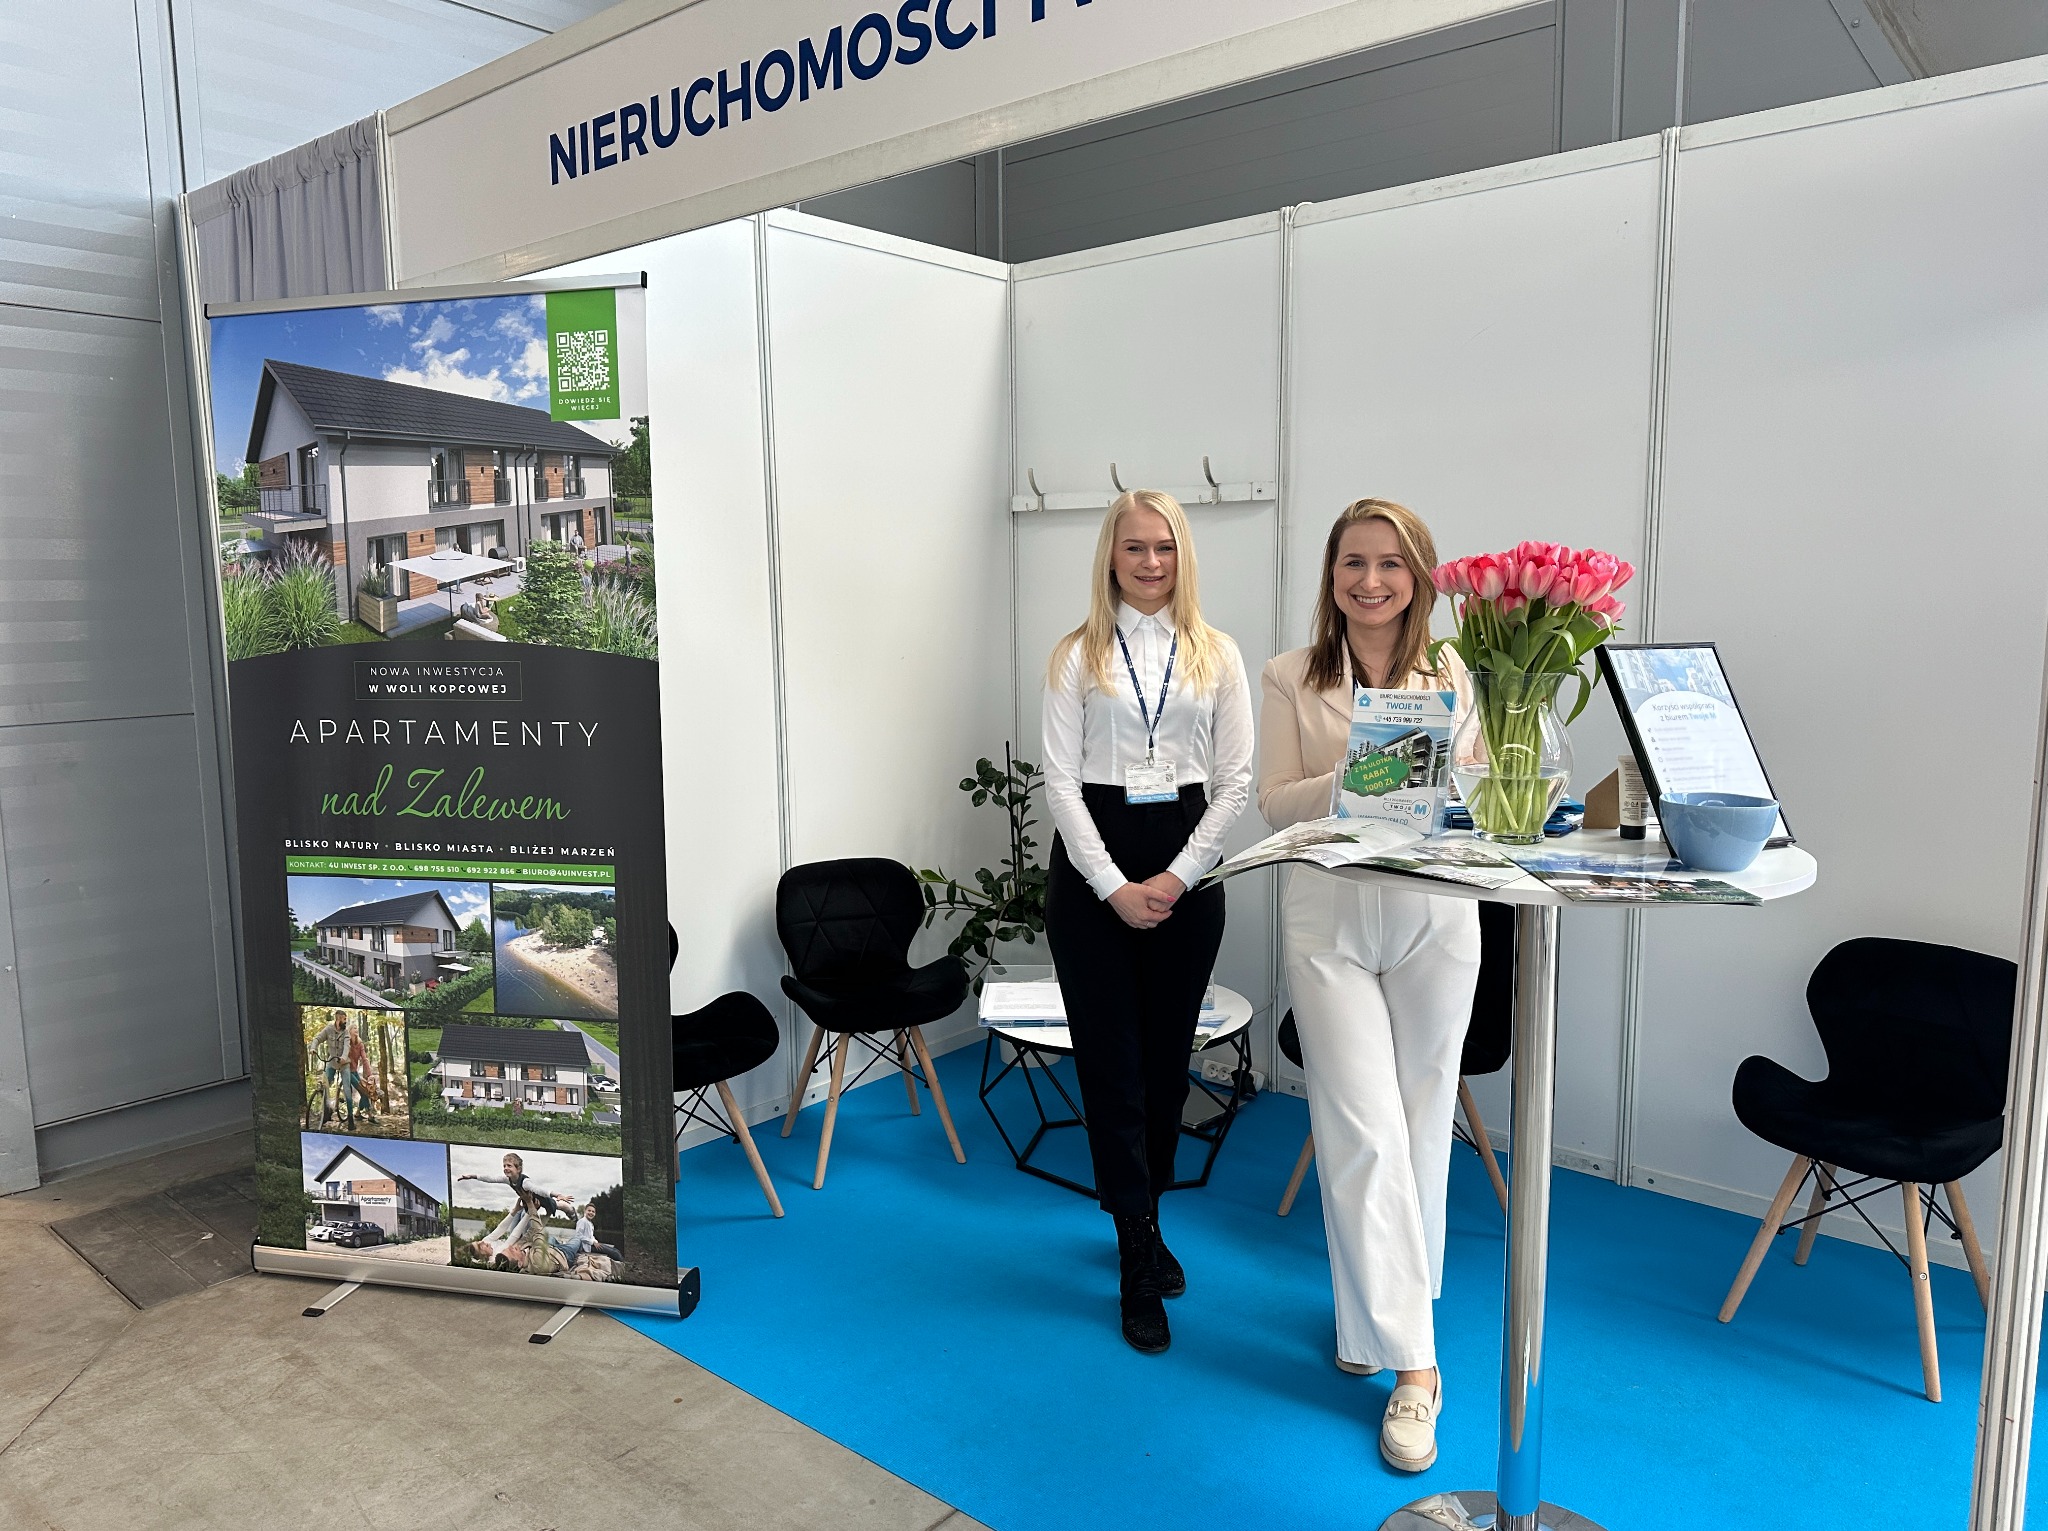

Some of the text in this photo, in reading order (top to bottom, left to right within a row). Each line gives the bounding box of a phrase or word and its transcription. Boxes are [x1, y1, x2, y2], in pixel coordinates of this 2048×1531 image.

[558, 396, 611, 405] DOWIEDZ SIĘ
[370, 666, 505, 677] NOWA INWESTYCJA
[368, 684, 508, 694] W WOLI KOPCOWEJ
[1385, 702, 1423, 711] TWOJE M
[289, 719, 599, 747] APARTAMENTY
[1368, 756, 1393, 768] ULOTKĄ
[1362, 766, 1390, 781] RABAT
[320, 763, 571, 821] nad Zalewem
[1364, 781, 1384, 792] 1000
[1413, 804, 1427, 815] M
[285, 839, 615, 857] BLISKO NATURY BLISKO MIASTA BLIŻEJ MARZEŃ
[289, 861, 326, 869] KONTAKT:
[368, 863, 380, 871] SP.
[466, 866, 481, 874] 692
[500, 867, 515, 875] 856
[522, 868, 611, 878] BIURO@4UINVEST.PL
